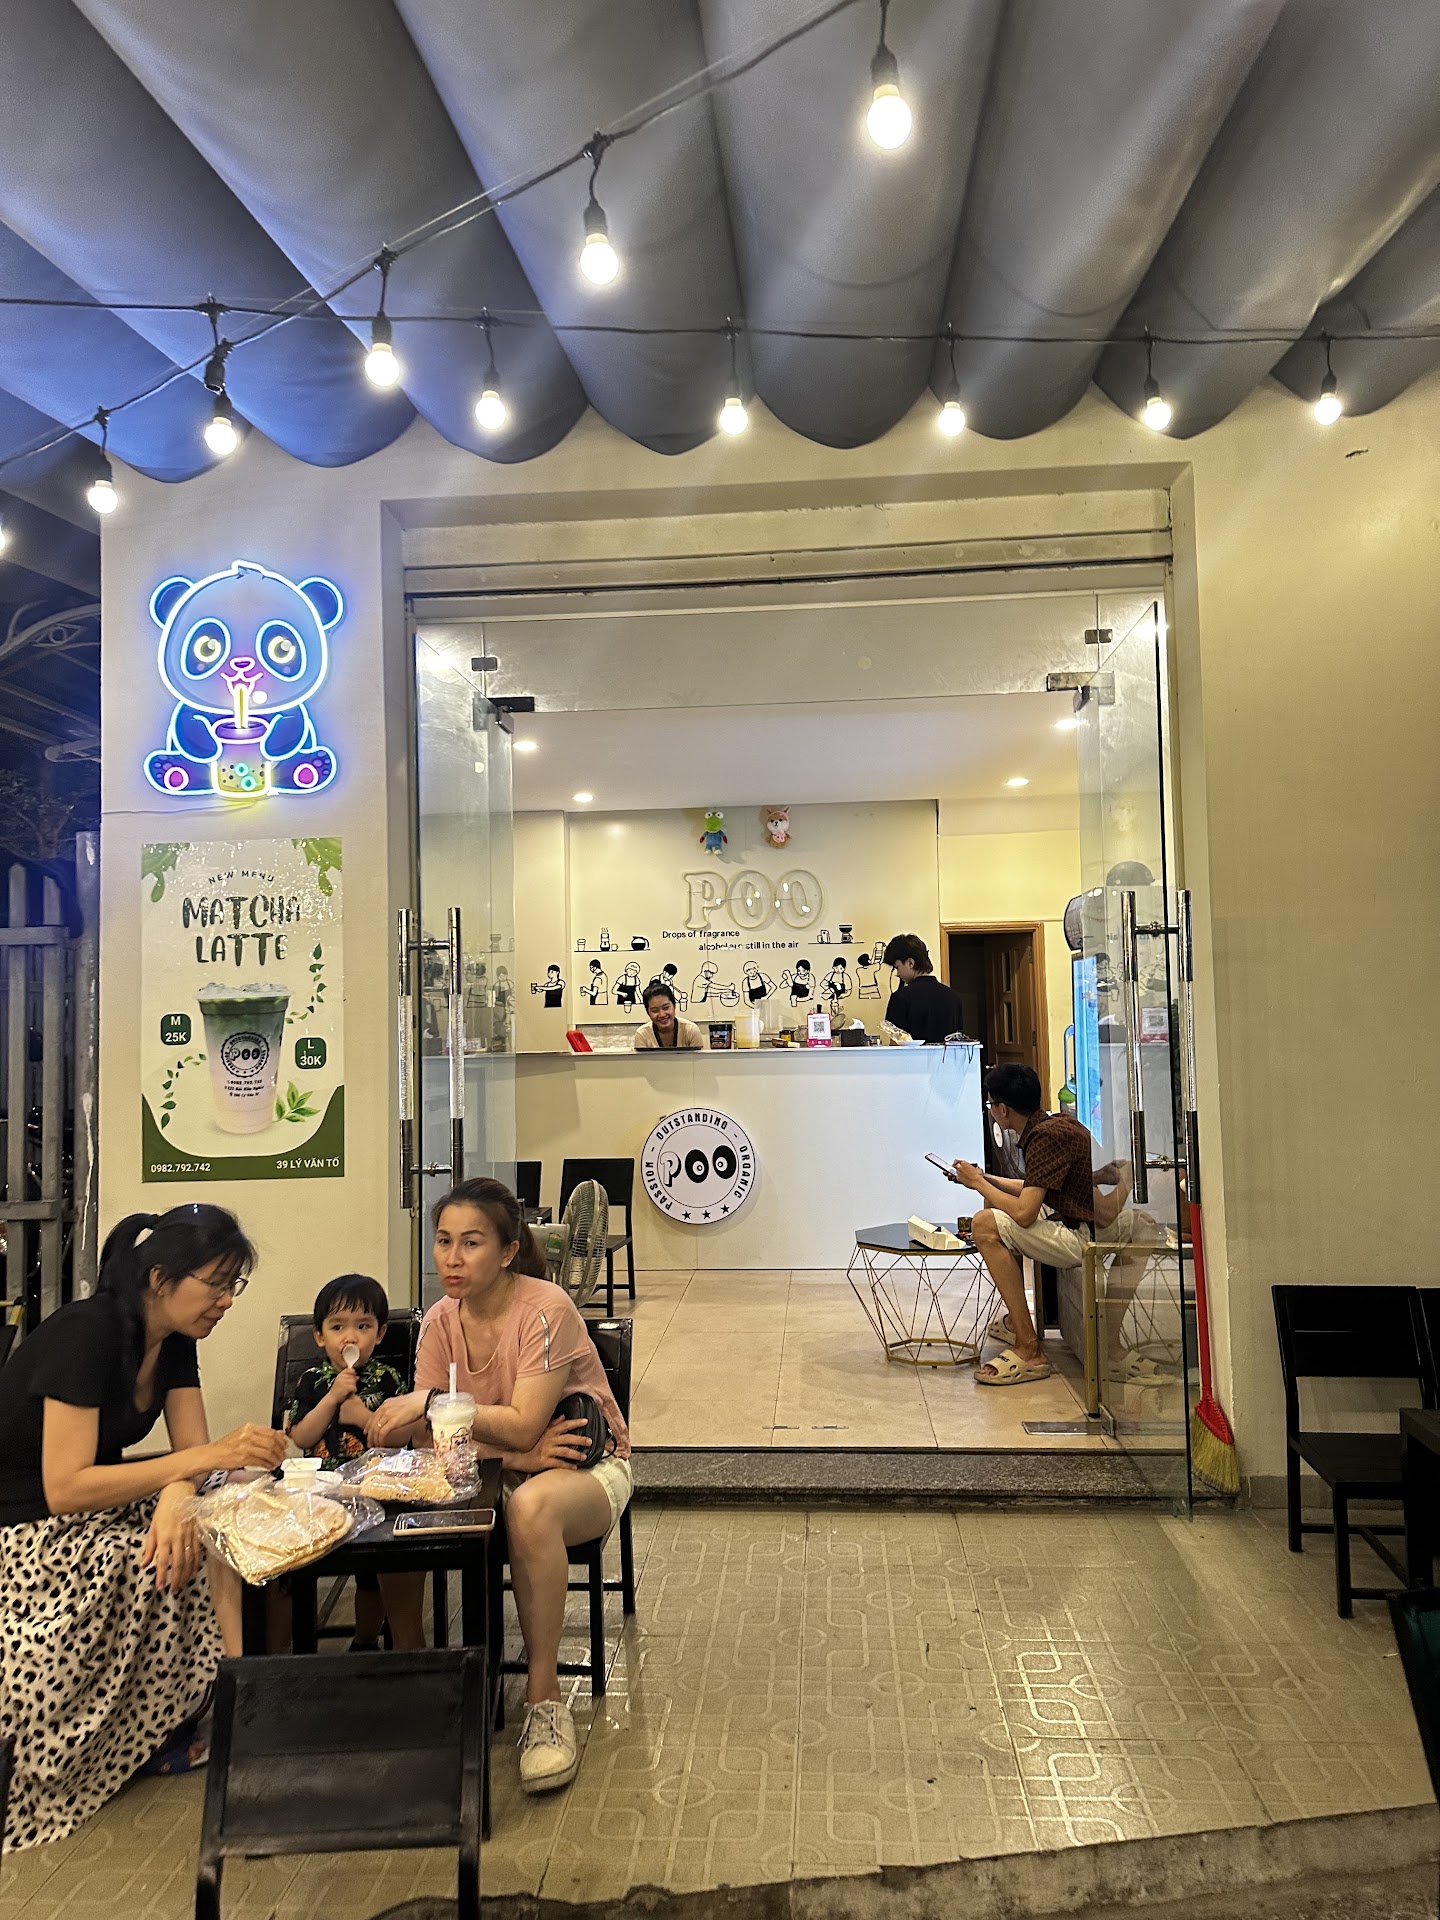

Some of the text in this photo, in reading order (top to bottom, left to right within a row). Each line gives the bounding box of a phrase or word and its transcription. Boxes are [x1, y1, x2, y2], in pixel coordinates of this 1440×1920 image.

[208, 870, 275, 884] NEW MENU
[683, 870, 823, 929] POO
[182, 894, 300, 929] MATCHA
[662, 930, 740, 939] Drops of fragrance
[196, 932, 288, 966] LATTE
[745, 942, 761, 950] still
[762, 941, 770, 949] in
[772, 941, 786, 949] the
[787, 941, 799, 949] air
[170, 1016, 181, 1026] M
[165, 1032, 187, 1043] 25K
[307, 1039, 315, 1049] L
[299, 1055, 322, 1066] 30K
[150, 1156, 340, 1173] 0982.792.742 39 LÝ VĂN TỐ
[645, 1113, 751, 1210] PASSION OUTSTANDING ORGANIC
